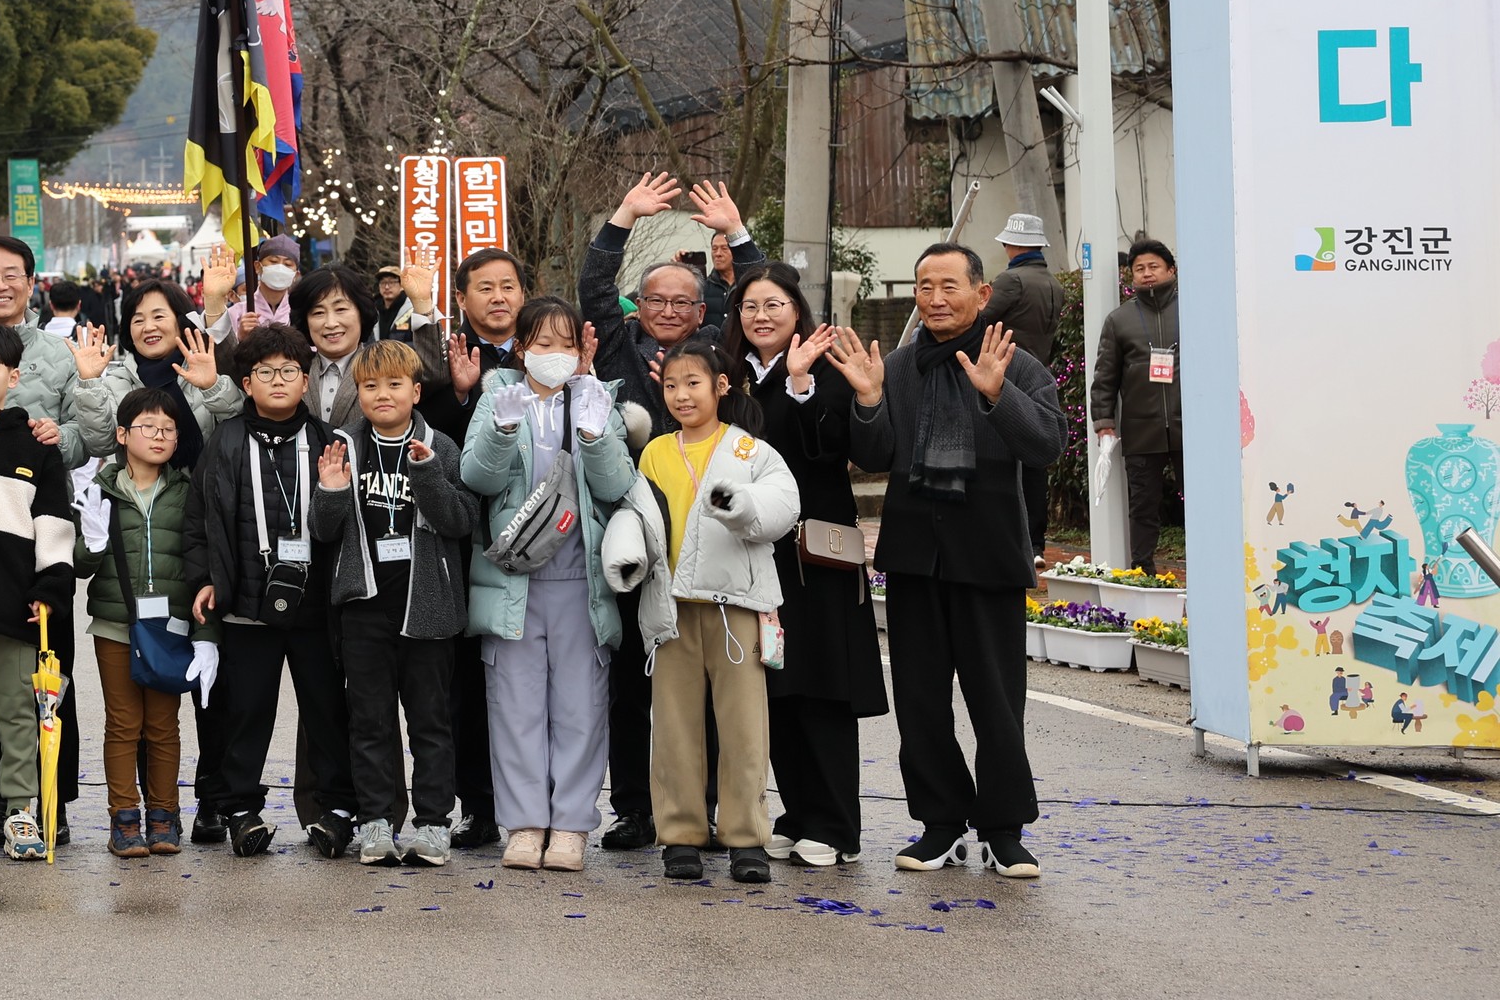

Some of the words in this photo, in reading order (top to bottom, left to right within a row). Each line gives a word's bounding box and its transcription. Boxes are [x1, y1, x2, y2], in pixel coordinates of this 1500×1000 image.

[1344, 227, 1452, 256] 강진군
[1344, 258, 1452, 273] GANGJINCITY
[500, 481, 547, 541] Supreme
[1277, 530, 1416, 613] 청자
[1352, 592, 1500, 704] 축제
